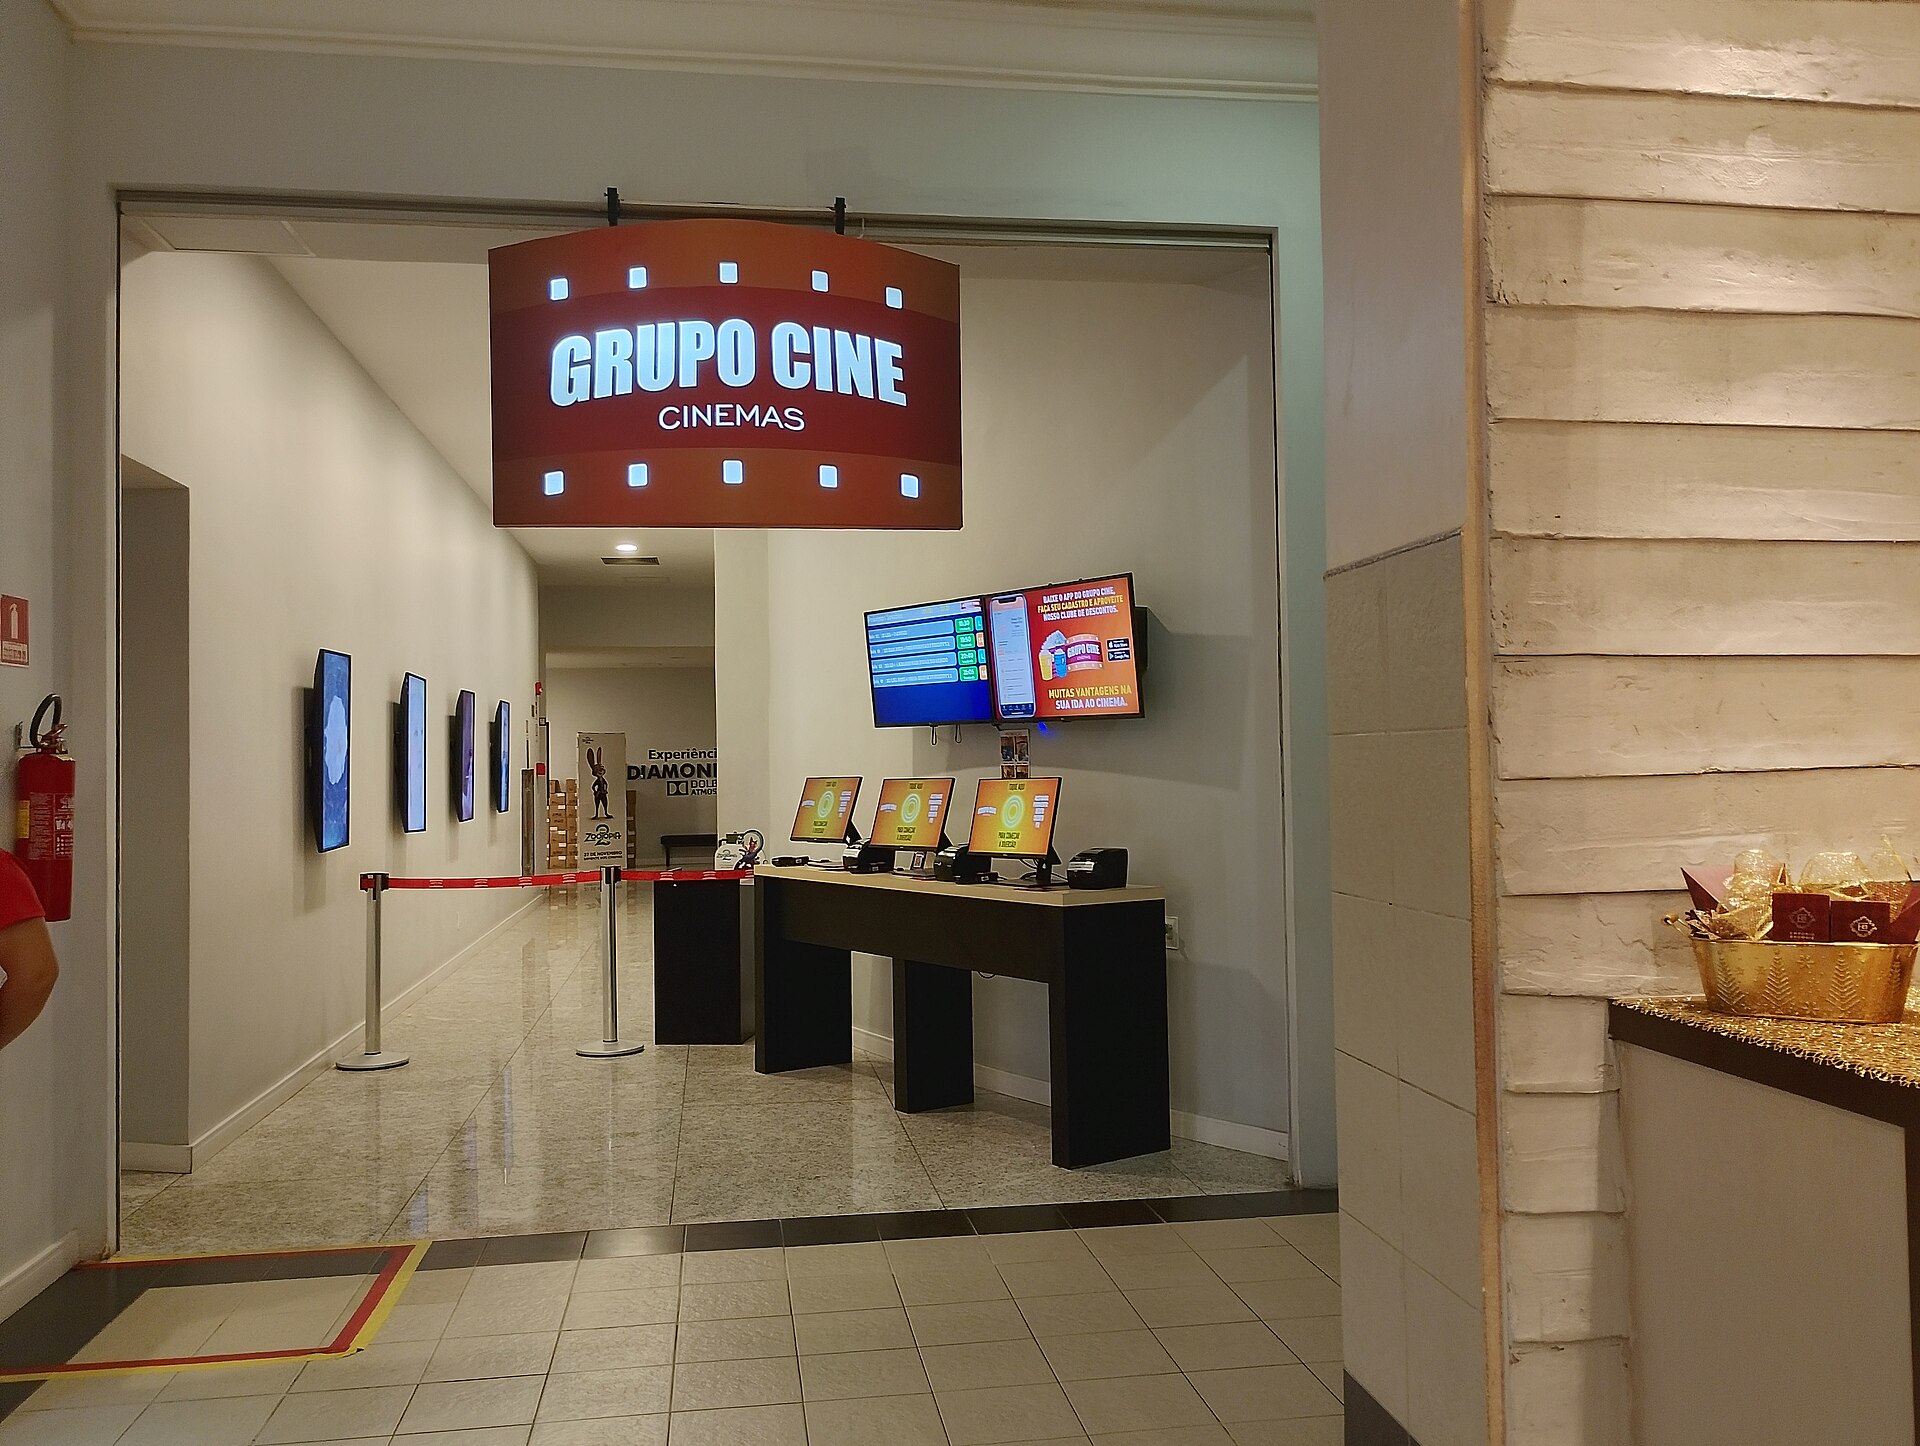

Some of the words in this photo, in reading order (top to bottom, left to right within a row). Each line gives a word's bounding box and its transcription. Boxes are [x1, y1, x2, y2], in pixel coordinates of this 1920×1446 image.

[549, 317, 756, 407] GRUPO
[770, 320, 908, 407] CINE
[658, 404, 805, 431] CINEMAS
[1043, 595, 1059, 603] BAIXE
[1082, 589, 1100, 598] GRUPO
[1051, 603, 1061, 611] SEU
[1062, 600, 1088, 610] CADASTRO
[1094, 595, 1123, 606] APROVEITE
[1043, 613, 1060, 621] NOSSO
[1061, 610, 1077, 619] CLUBE
[1078, 609, 1085, 617] DE
[1067, 644, 1085, 658] GRUPO
[1086, 643, 1100, 654] CINE
[1048, 688, 1074, 698] MUITAS
[1076, 686, 1119, 697] VANTAGENS
[1120, 685, 1132, 694] NA
[1055, 699, 1070, 710] SUA
[1071, 699, 1084, 708] IDA
[1085, 699, 1095, 708] AO
[1096, 697, 1128, 707] CINEMA.
